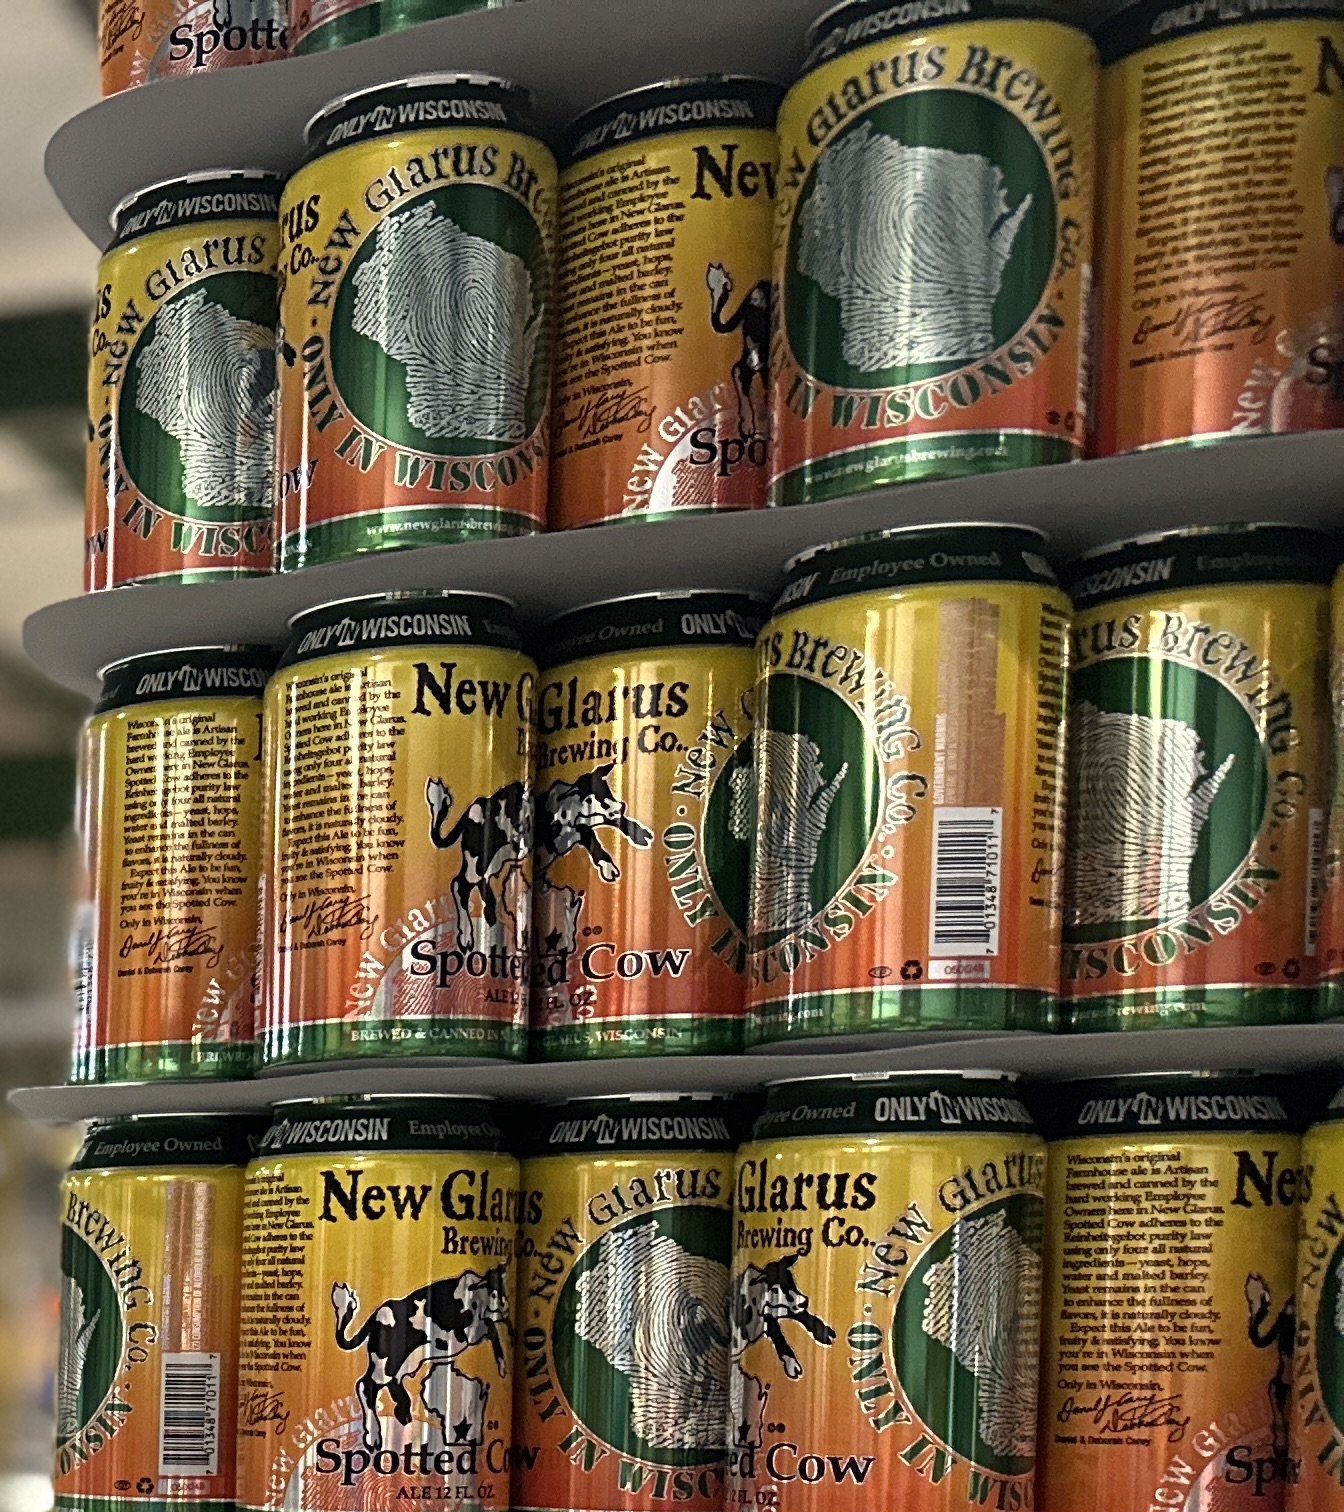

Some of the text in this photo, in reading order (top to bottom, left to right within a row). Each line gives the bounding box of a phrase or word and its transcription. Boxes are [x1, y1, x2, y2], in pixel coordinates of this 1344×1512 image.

[397, 98, 506, 123] WISCONSIN
[805, 44, 949, 148] Glarus
[959, 43, 1076, 200] Brewing
[308, 143, 498, 309] New Glarus
[103, 233, 266, 387] New Glarus
[829, 308, 1067, 431] WISCONSIN
[334, 420, 387, 474] IN
[121, 502, 159, 540] IN
[828, 551, 1002, 584] Employee Owned
[296, 614, 472, 654] ONLY WISCONSIN
[681, 613, 728, 635] ONLY
[136, 668, 177, 695] ONLY
[411, 661, 510, 716] New
[538, 671, 690, 737] Glarus
[785, 634, 923, 763] Brewing
[1160, 611, 1300, 756] Brewing
[669, 708, 736, 798] New
[663, 821, 719, 928] ONLY
[983, 835, 999, 930] 01348 71011
[582, 941, 690, 979] Cow
[351, 1027, 485, 1042] BREWED CANNED
[287, 1117, 481, 1144] WISCONSIN Employee
[550, 1117, 729, 1144] ONLY WISCONSIN
[792, 1096, 931, 1122] Owned ONLY
[1078, 1096, 1287, 1125] ONLY WISCONSIN
[94, 1136, 223, 1157] Employee Owned
[318, 1169, 430, 1225] New
[737, 1160, 877, 1215] Glarus
[938, 1151, 1046, 1213] Glarus
[529, 1166, 723, 1302] New Glarus
[1150, 1205, 1181, 1214] New
[67, 1191, 154, 1312] Brewing
[736, 1221, 813, 1255] Brewing
[856, 1202, 934, 1298] New
[524, 1325, 608, 1472] ONLY IN
[847, 1321, 913, 1434] ONLY
[205, 1375, 217, 1466] 01348 71011
[315, 1438, 479, 1488] Spotted
[766, 1443, 875, 1485] Cow
[898, 1431, 957, 1485] IN
[395, 1485, 432, 1500] ALE
[435, 1485, 451, 1499] 12
